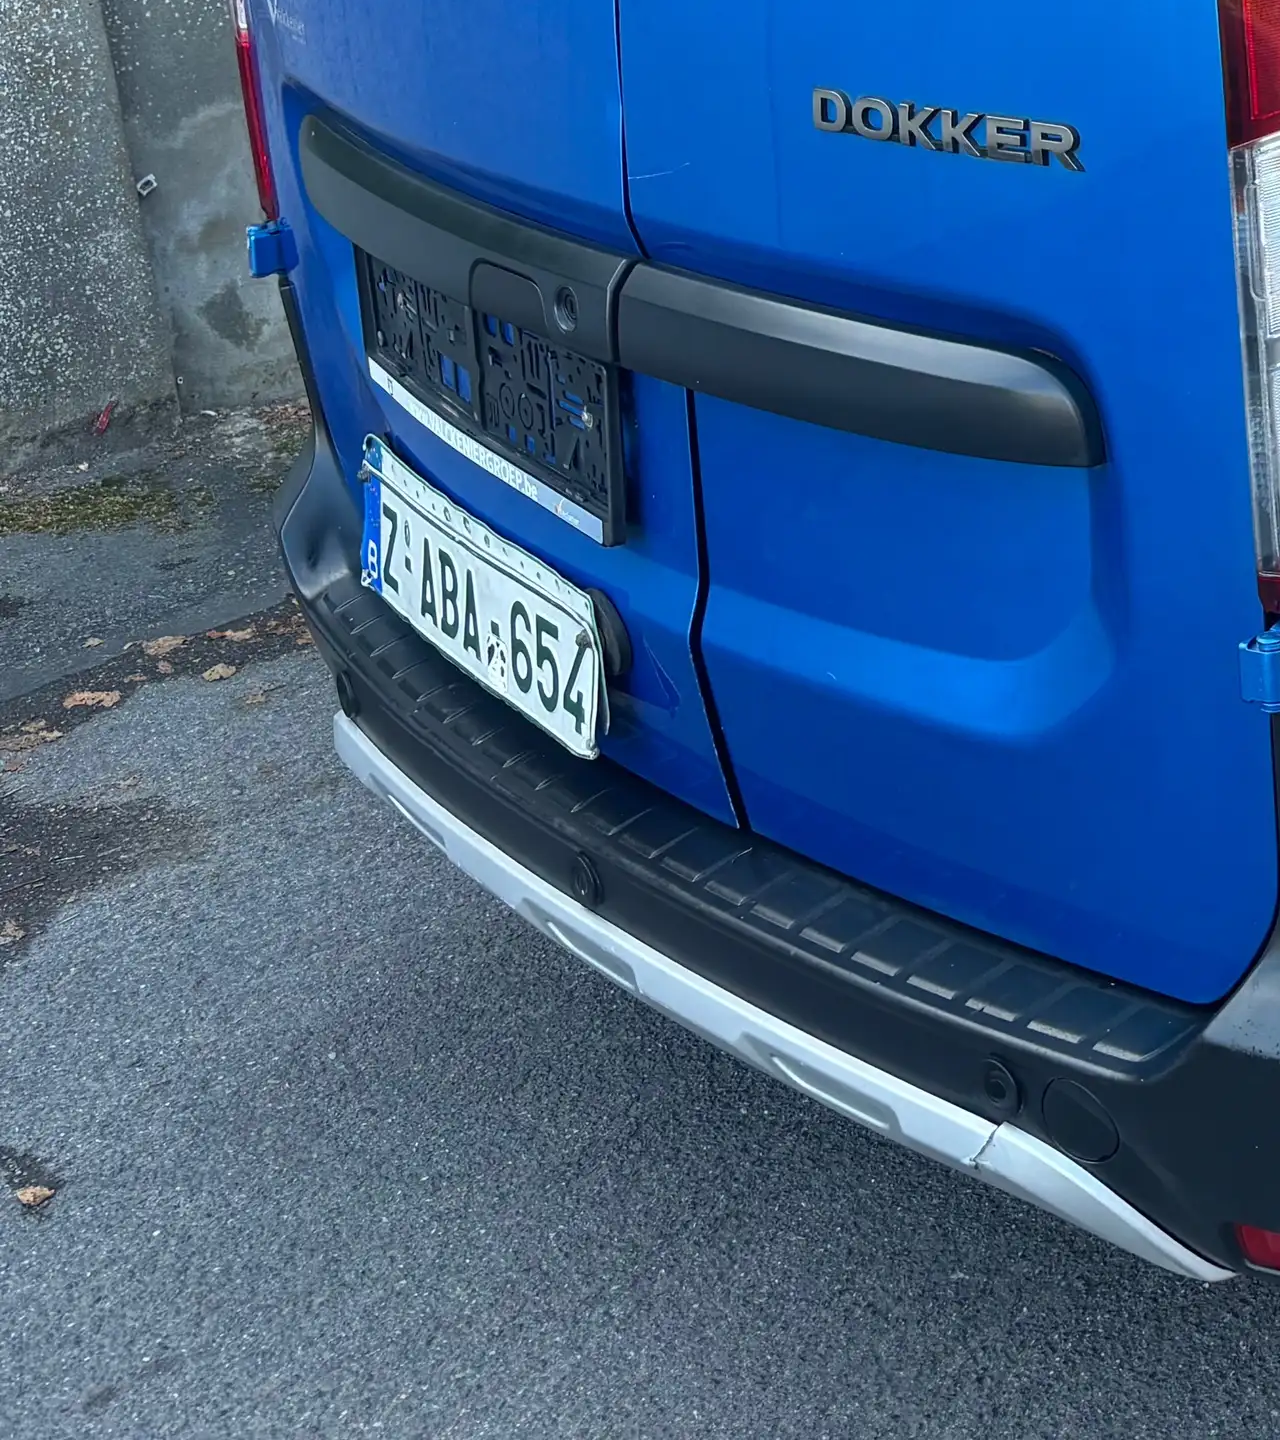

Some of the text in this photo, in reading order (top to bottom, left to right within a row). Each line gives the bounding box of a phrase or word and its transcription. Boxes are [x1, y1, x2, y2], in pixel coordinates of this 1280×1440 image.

[812, 86, 1086, 173] DOKKER
[367, 502, 587, 736] B Z-ABA-654
